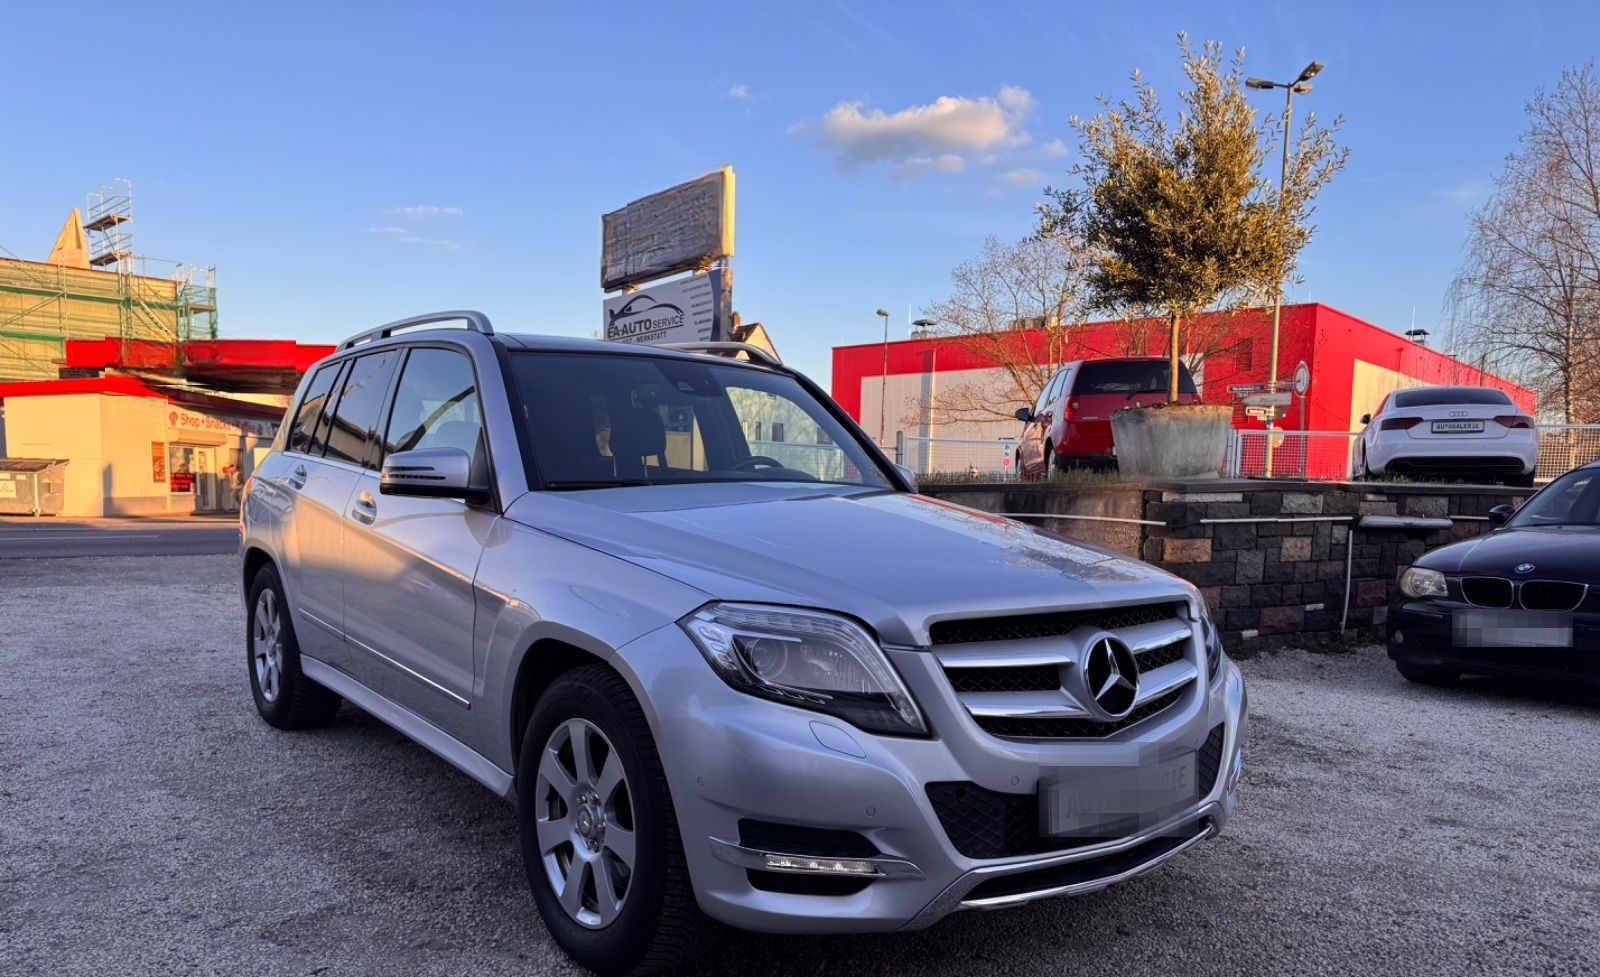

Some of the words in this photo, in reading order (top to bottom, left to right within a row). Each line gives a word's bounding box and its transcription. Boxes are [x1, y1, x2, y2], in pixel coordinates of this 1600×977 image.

[652, 315, 685, 328] SERVICE
[636, 331, 667, 343] WERKSTATT
[180, 412, 200, 429] Shop
